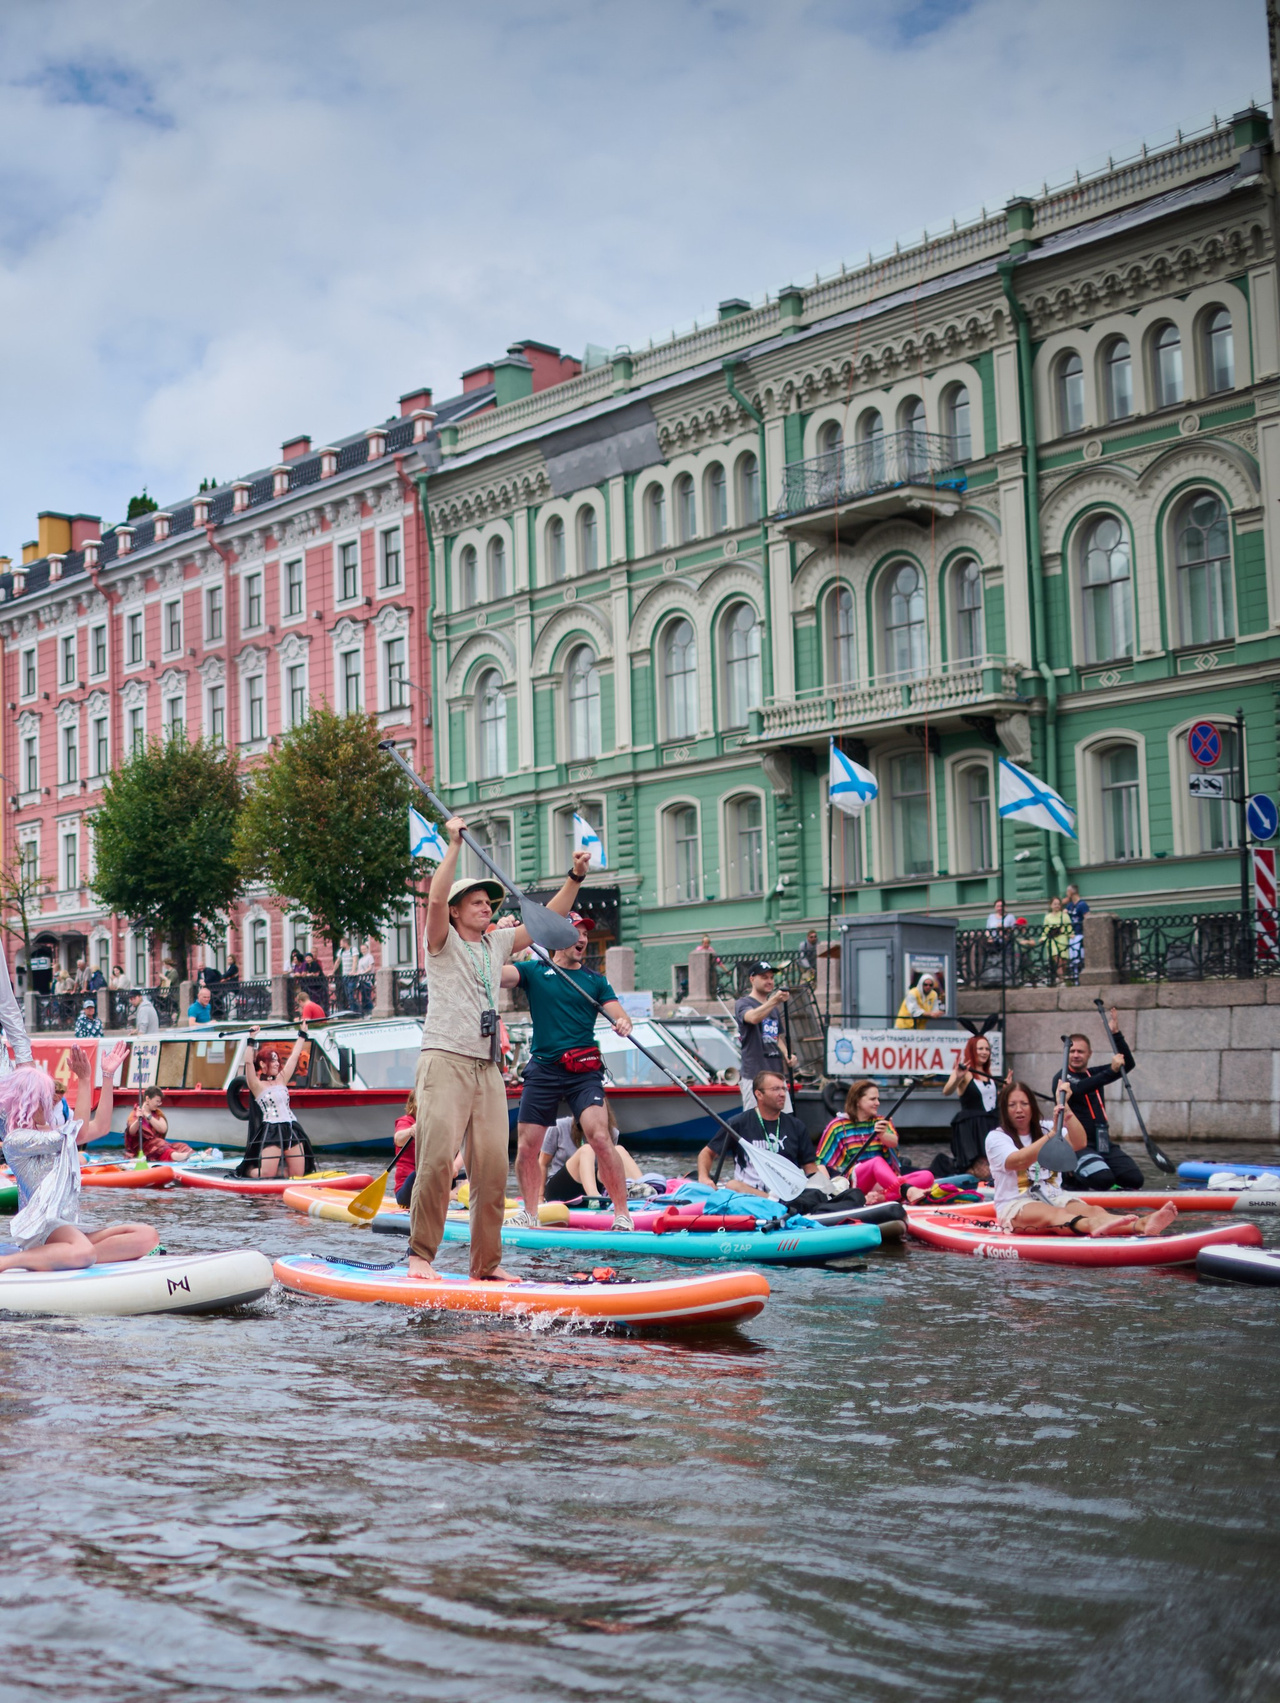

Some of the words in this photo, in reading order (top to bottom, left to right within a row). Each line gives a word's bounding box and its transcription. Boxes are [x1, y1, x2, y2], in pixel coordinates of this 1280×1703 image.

[862, 1044, 944, 1070] МОЙКА
[733, 1243, 752, 1253] ZAP
[986, 1245, 1019, 1259] Konda
